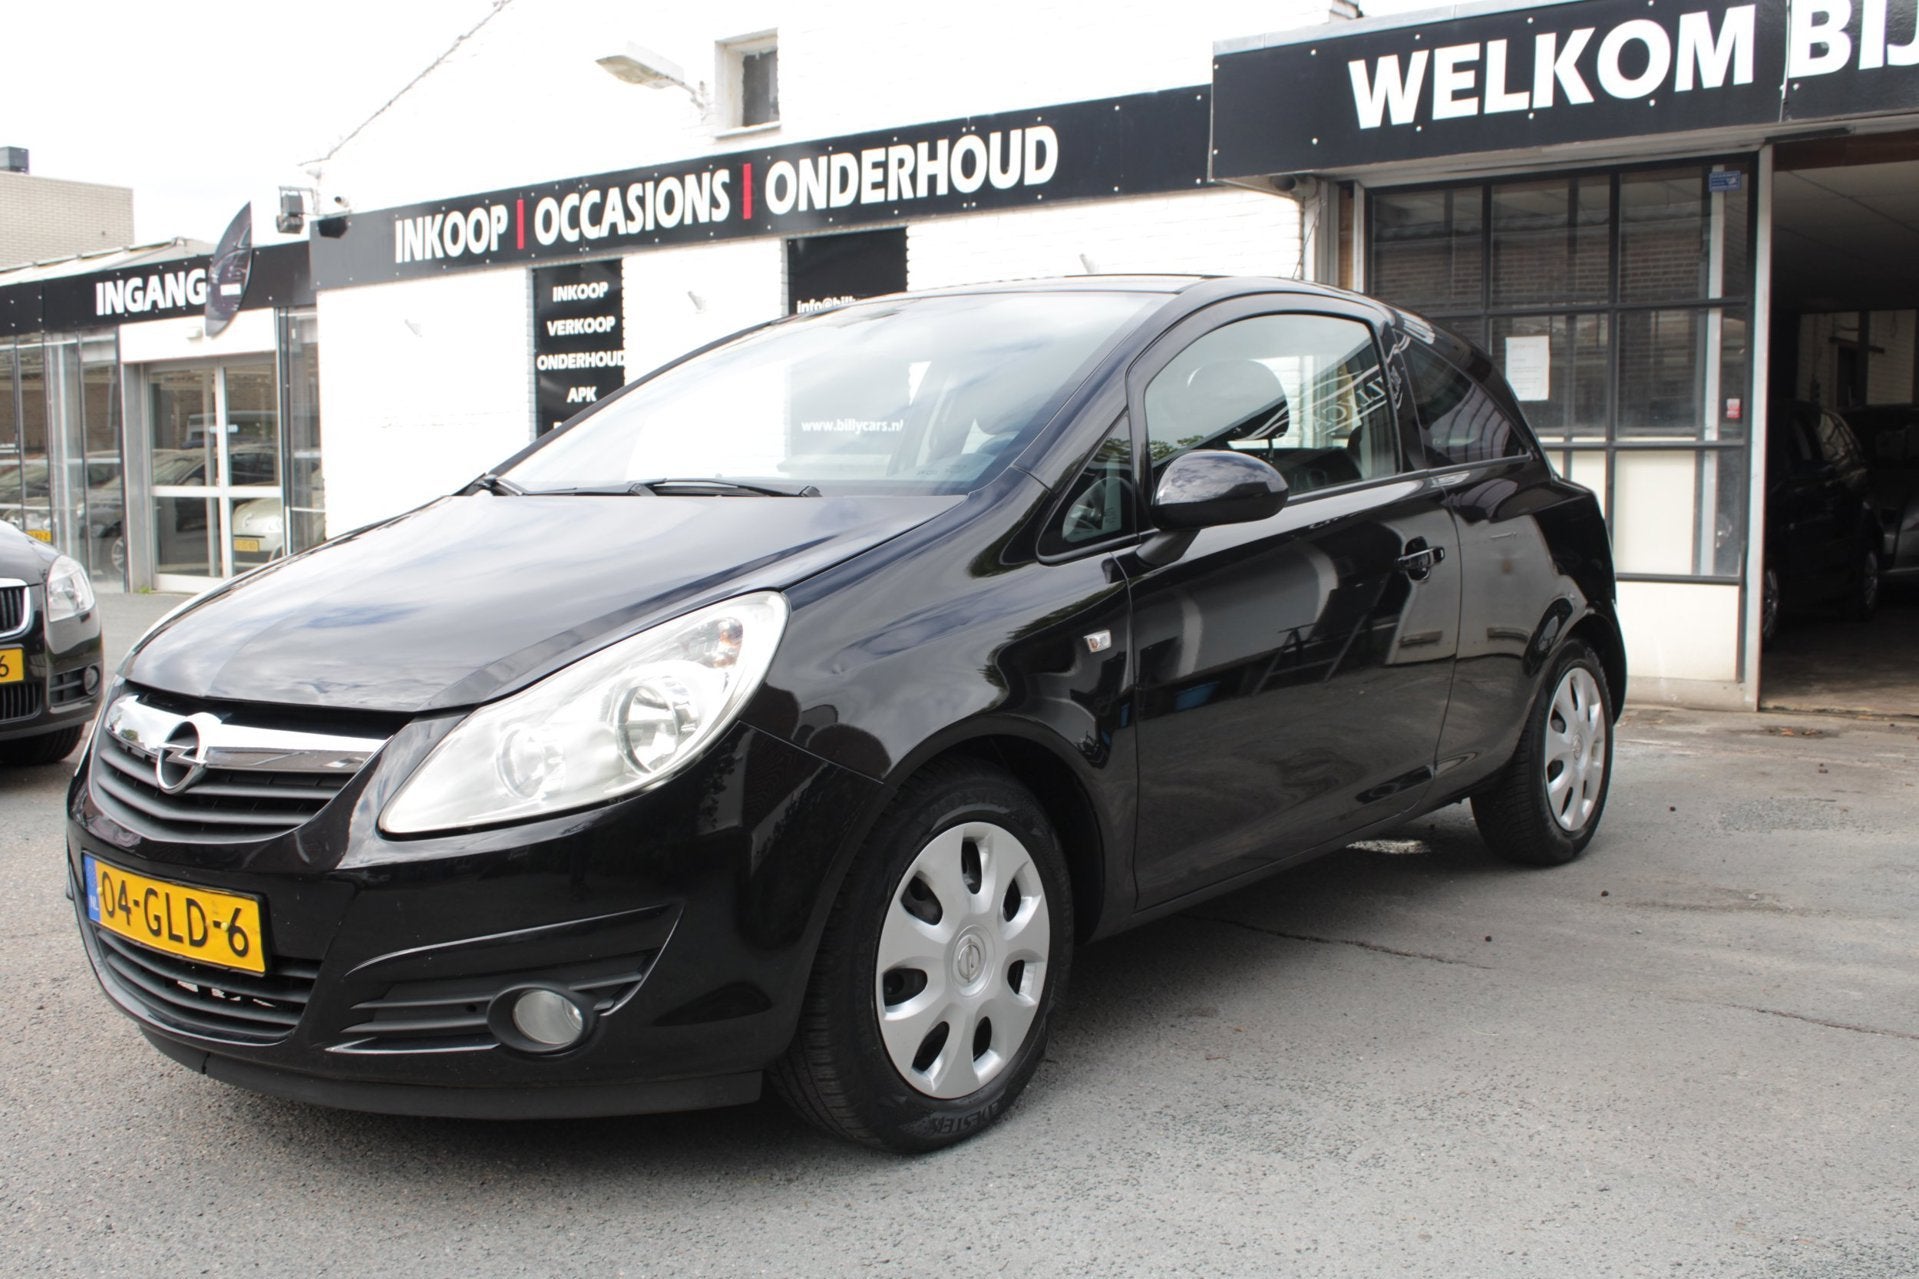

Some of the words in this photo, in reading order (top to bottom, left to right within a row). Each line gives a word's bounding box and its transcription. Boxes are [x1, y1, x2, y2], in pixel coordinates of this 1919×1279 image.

[1348, 4, 1755, 129] WELKOM
[395, 205, 508, 264] INKOOP
[535, 169, 731, 246] OCCASIONS
[766, 126, 1059, 216] ONDERHOUD
[96, 268, 207, 315] INGANG
[552, 282, 608, 302] INKOOP
[547, 316, 615, 336] VERKOOP
[537, 350, 625, 370] ONDERHOUD
[567, 387, 597, 403] APK
[801, 418, 904, 434] www.billycars.nl
[102, 871, 249, 957] 04-GLD-6
